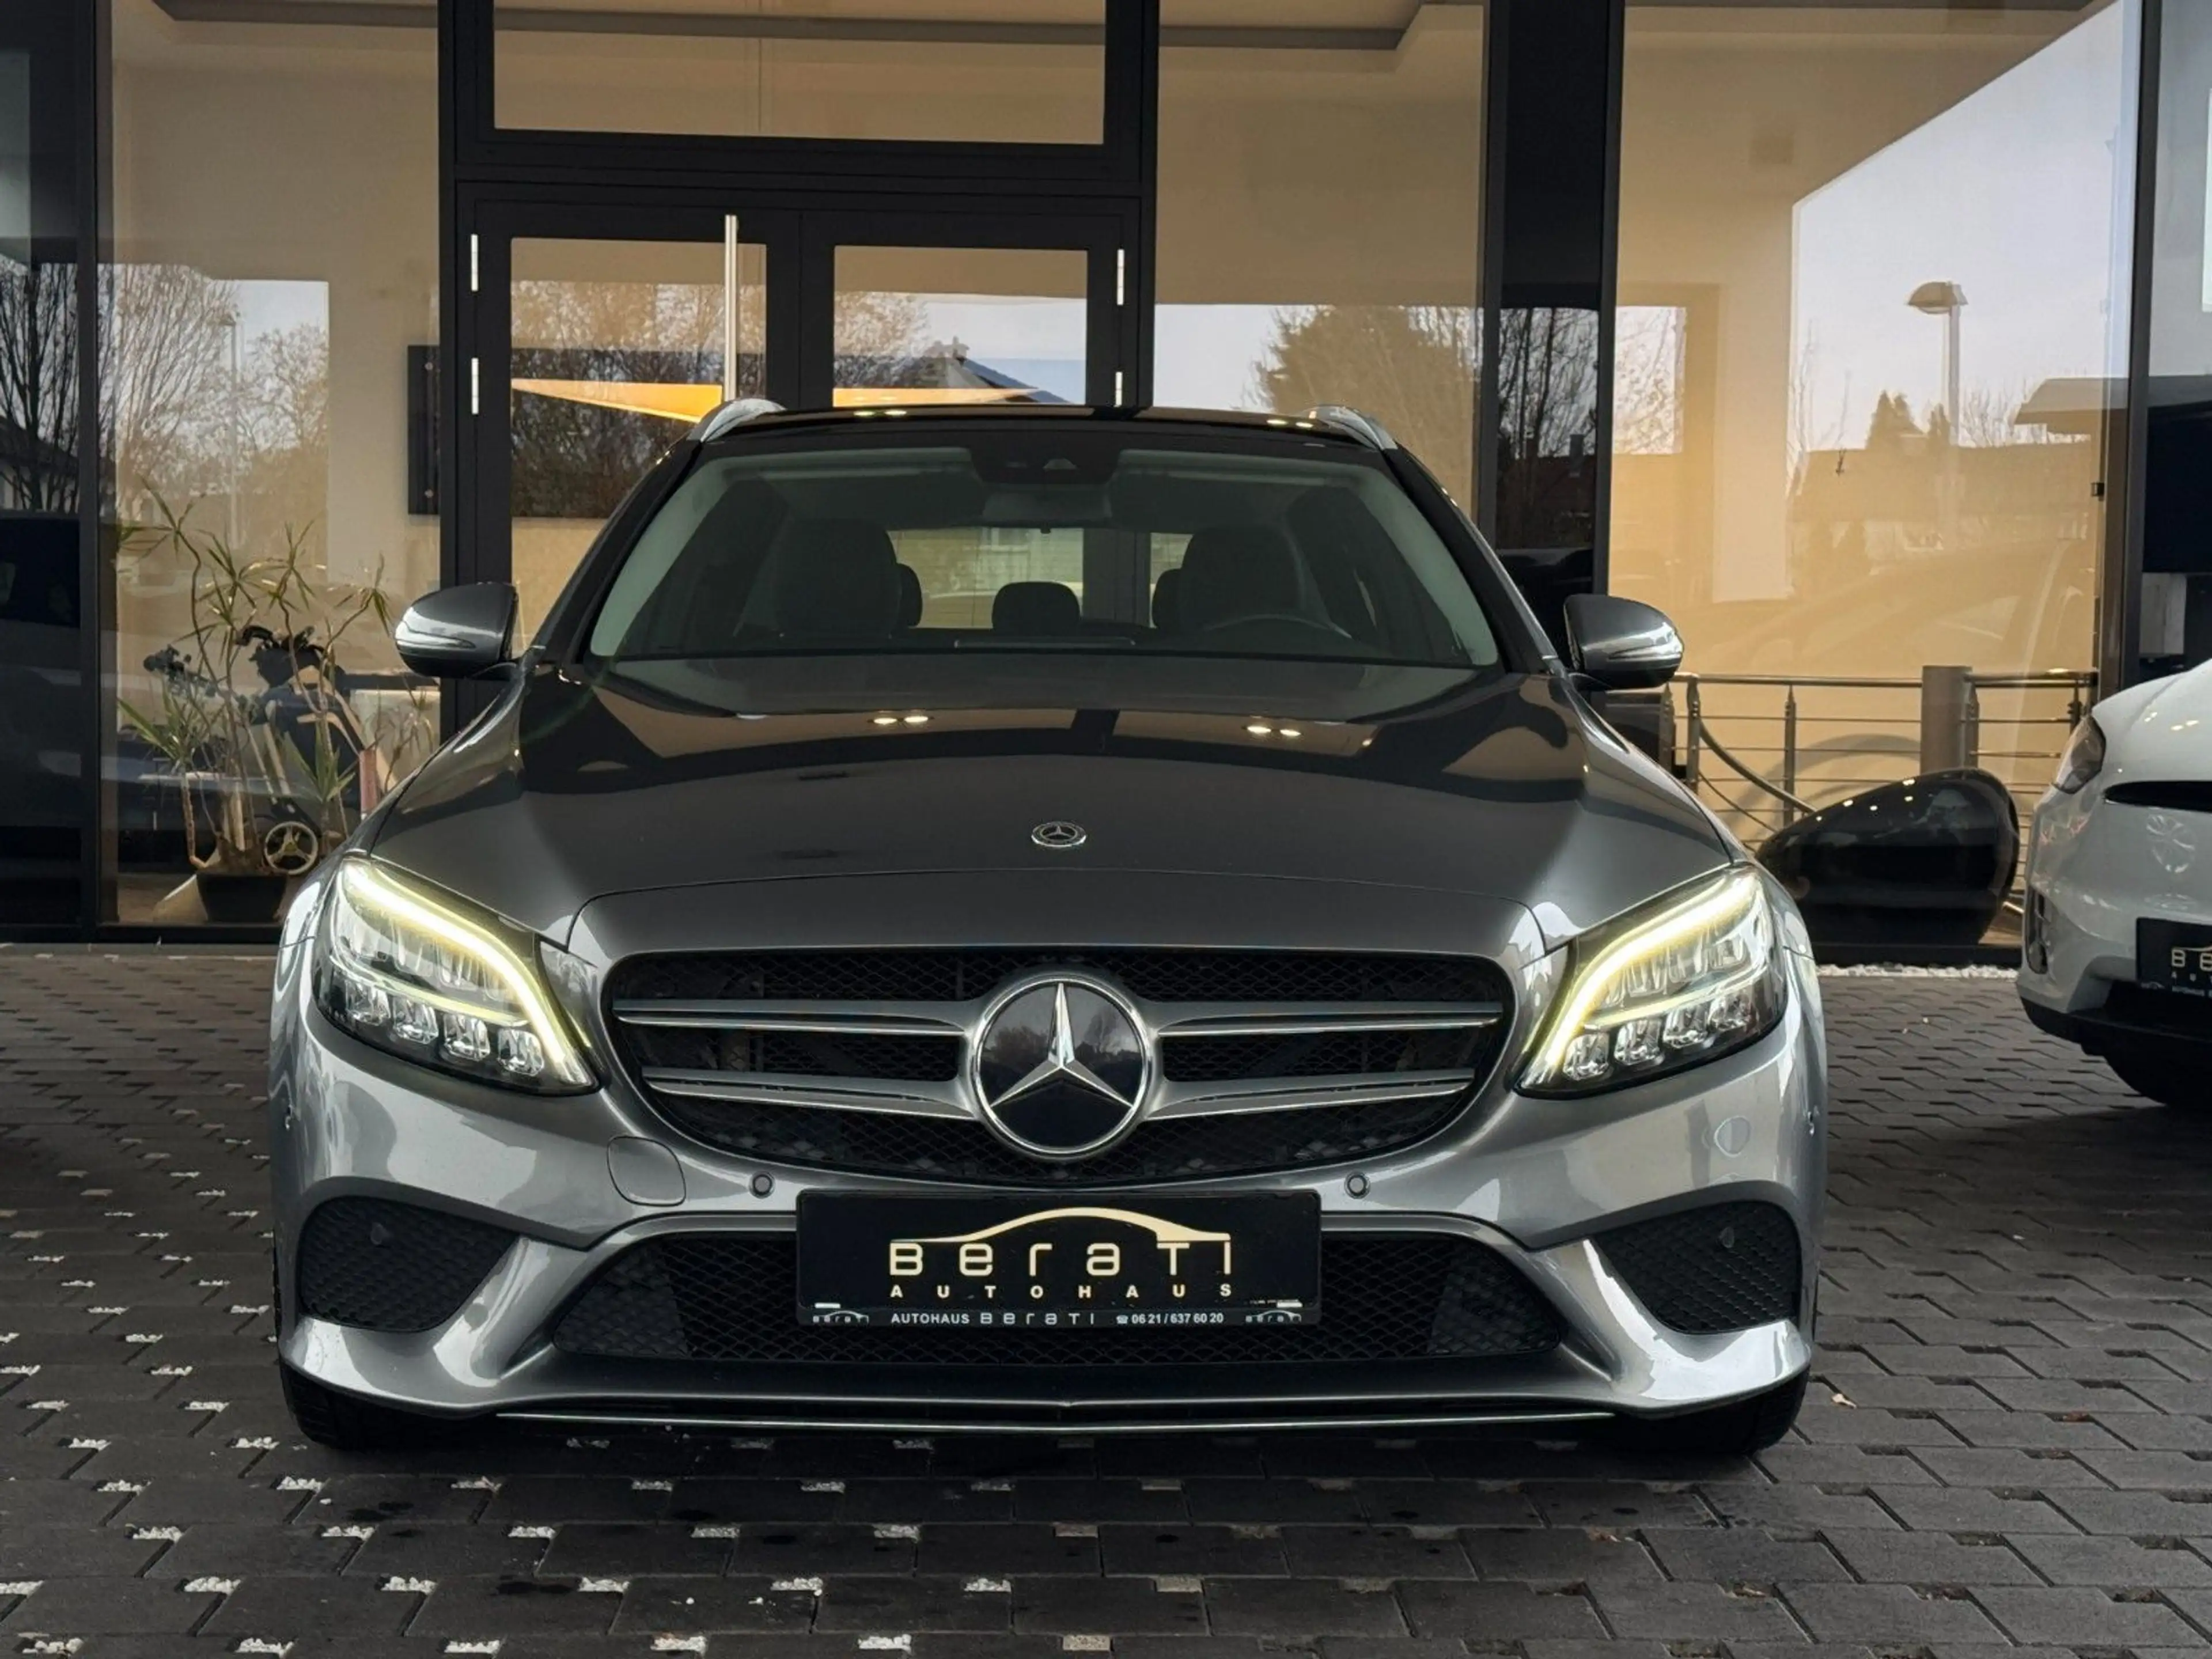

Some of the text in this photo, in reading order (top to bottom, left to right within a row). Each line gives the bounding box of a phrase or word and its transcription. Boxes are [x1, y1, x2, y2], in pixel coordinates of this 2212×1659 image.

[891, 1284, 1232, 1298] AUTOHAUS
[891, 1313, 970, 1324] AUTOHAUS
[1171, 1313, 1191, 1324] 637
